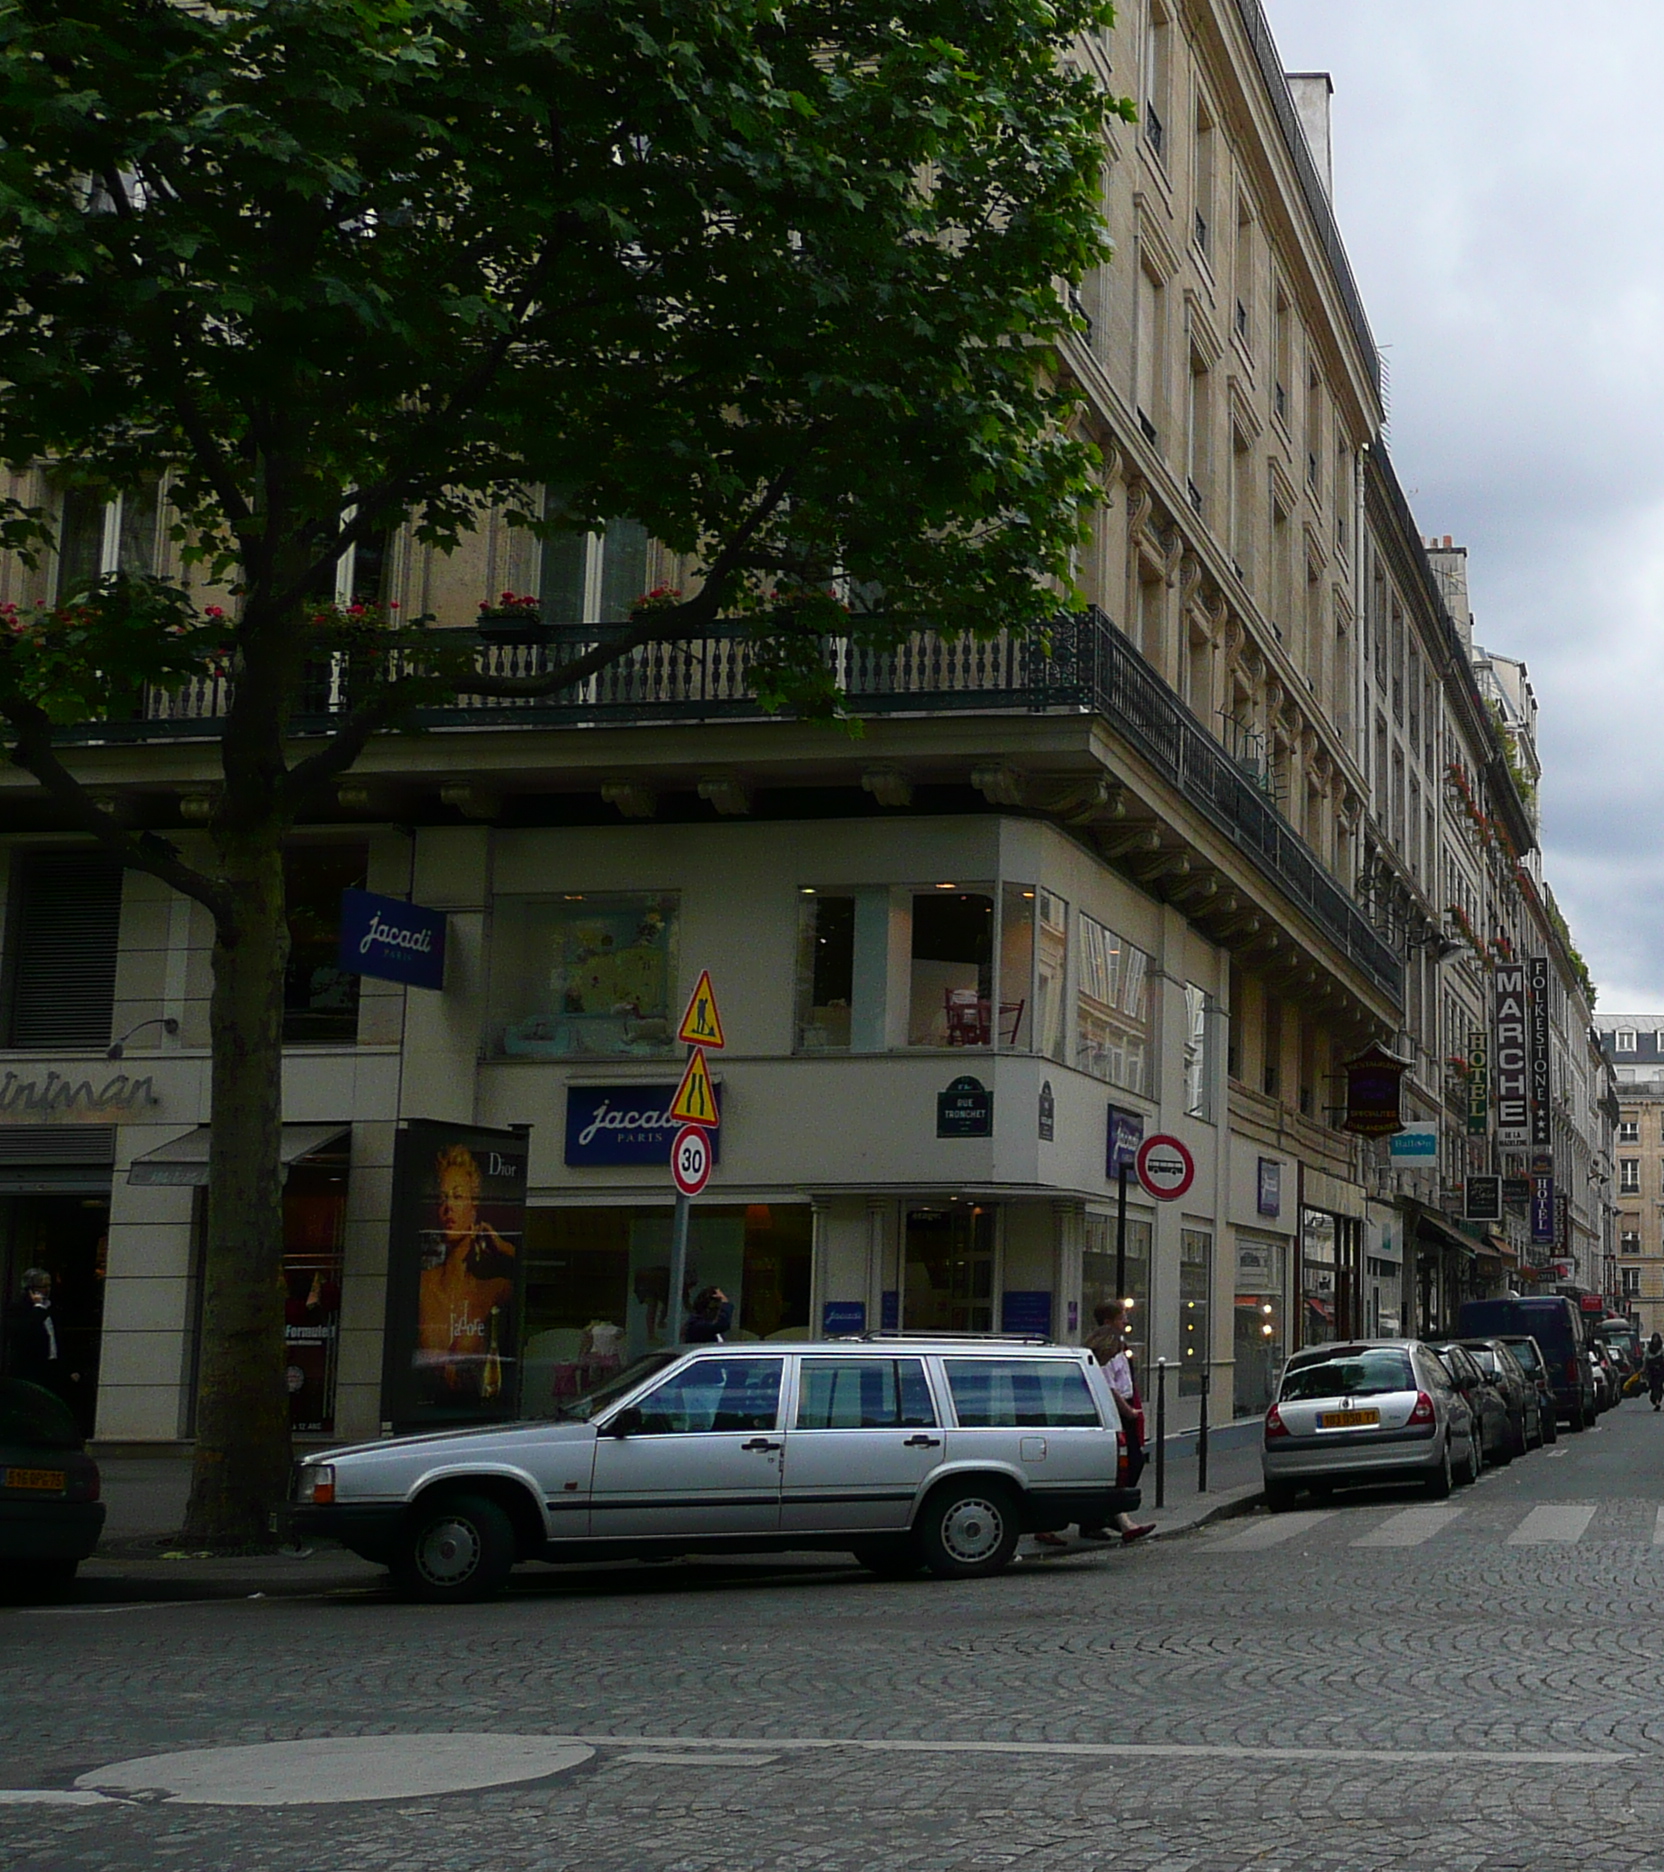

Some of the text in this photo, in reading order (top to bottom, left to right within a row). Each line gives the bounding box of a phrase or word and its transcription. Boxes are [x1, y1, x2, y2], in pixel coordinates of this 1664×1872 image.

[359, 910, 431, 954] jacadi
[1497, 971, 1526, 1122] MARCHE
[1532, 962, 1548, 1101] FOLKESTONE
[1469, 1034, 1486, 1117] HOTEL
[944, 1109, 987, 1119] TRONCHET
[956, 1098, 974, 1108] RUE
[617, 1133, 663, 1143] PARIS
[682, 1148, 702, 1173] 30
[1537, 1178, 1547, 1231] HOTEL
